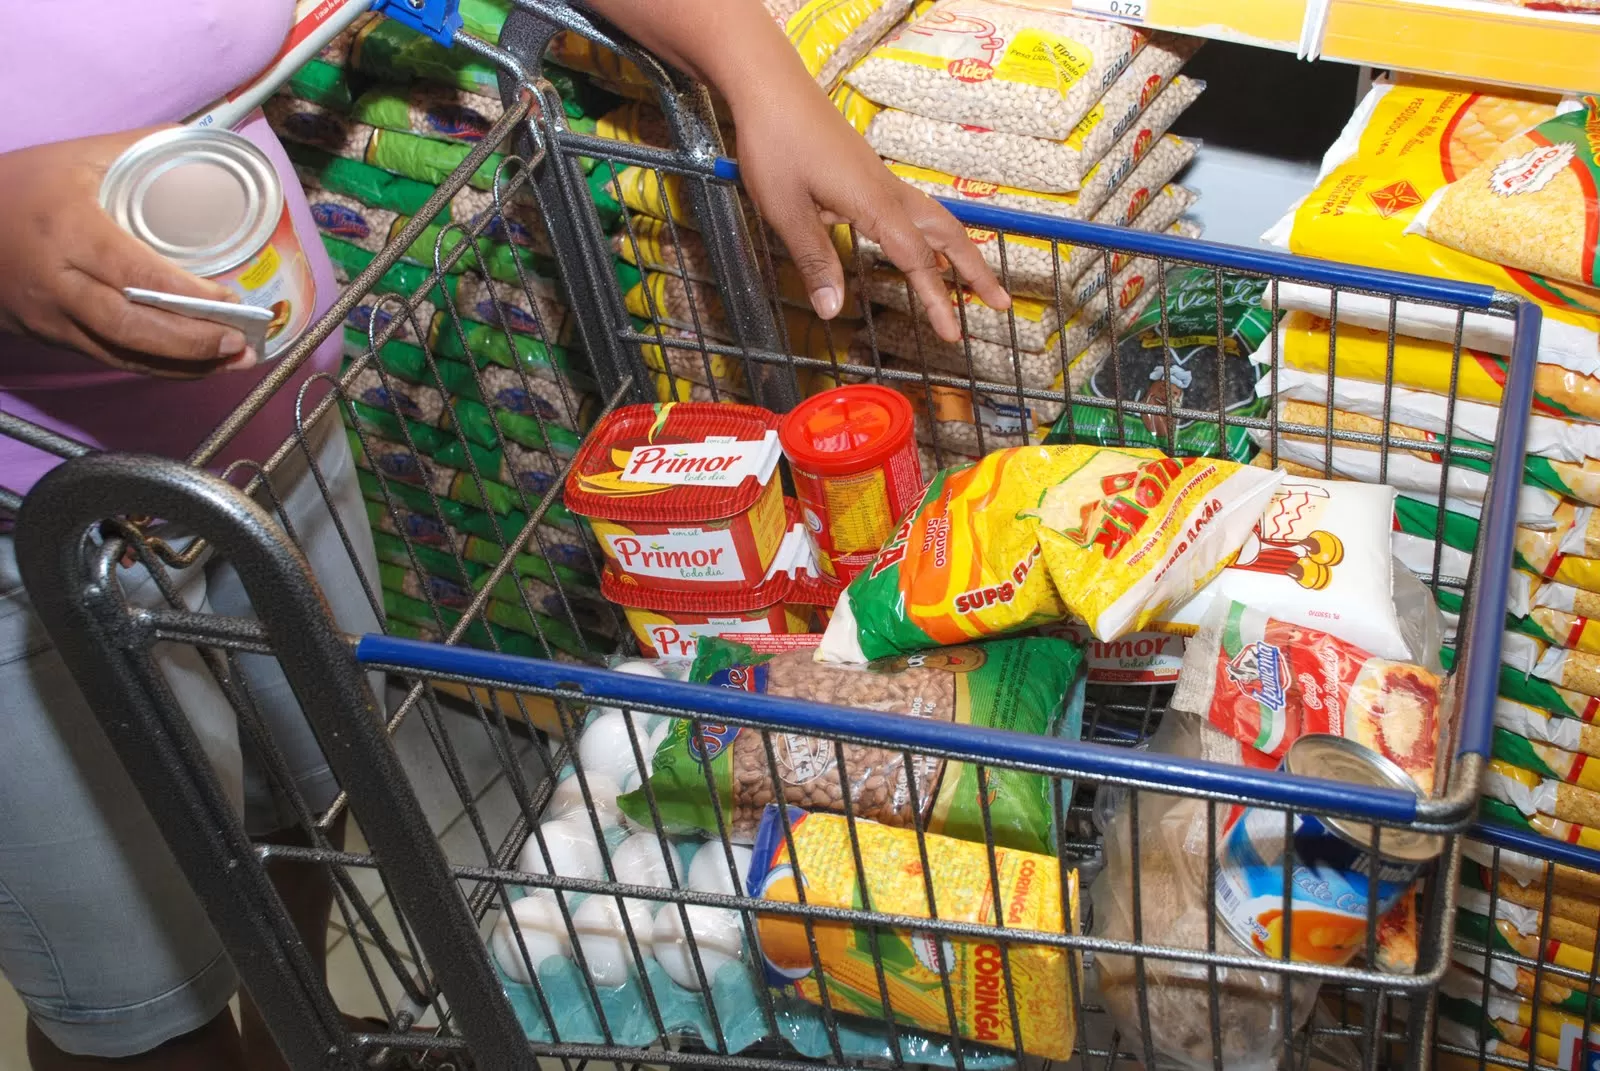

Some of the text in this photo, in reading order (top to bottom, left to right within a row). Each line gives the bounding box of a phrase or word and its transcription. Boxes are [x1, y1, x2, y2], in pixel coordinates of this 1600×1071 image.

[1110, 1, 1142, 17] 0,72
[1053, 42, 1077, 63] Tipo
[1101, 51, 1130, 93] FEIJÃO
[629, 446, 743, 476] Primor
[708, 472, 727, 482] dia
[1187, 465, 1217, 491] FARINHA
[613, 537, 724, 570] Primor
[680, 566, 725, 579] todo dia
[652, 627, 697, 657] Pri
[1088, 635, 1171, 660] imor
[1146, 655, 1168, 667] dia
[1252, 641, 1280, 711] Ipanema
[788, 735, 815, 782] EXT
[1006, 859, 1036, 924] CORINGA
[974, 944, 1002, 1041] CORINGA
